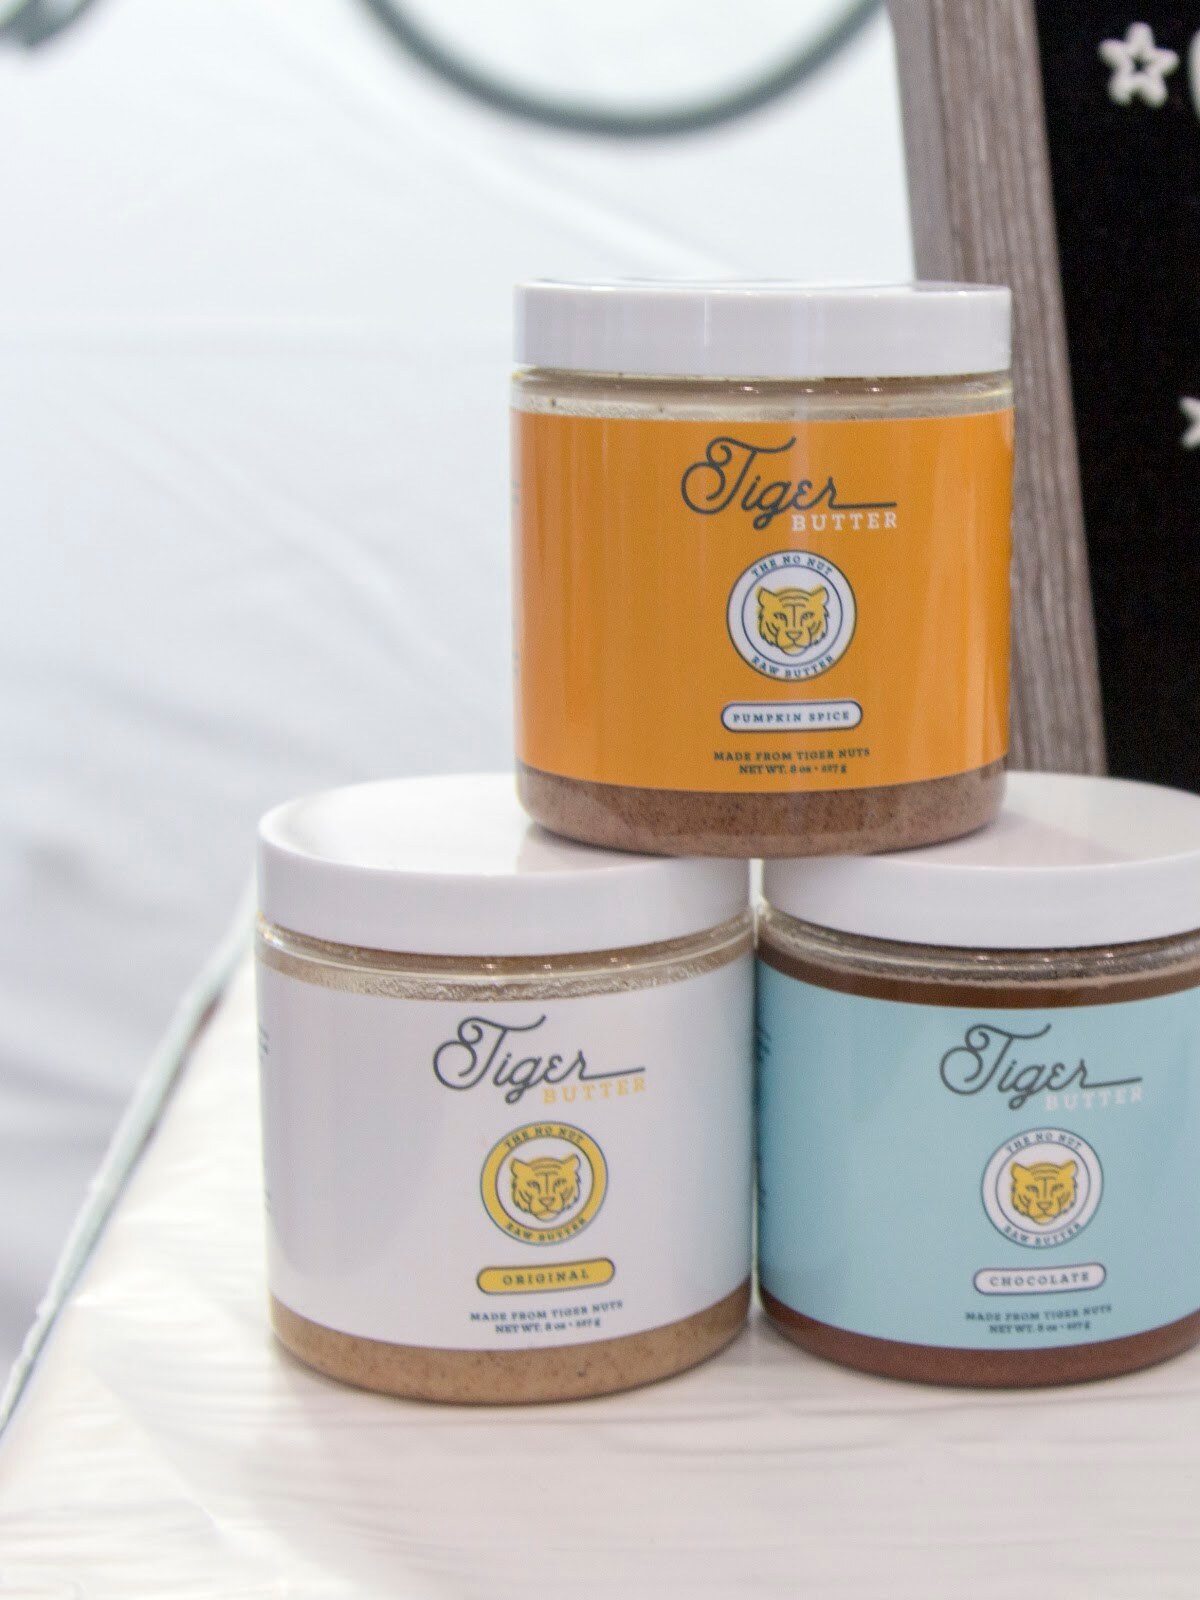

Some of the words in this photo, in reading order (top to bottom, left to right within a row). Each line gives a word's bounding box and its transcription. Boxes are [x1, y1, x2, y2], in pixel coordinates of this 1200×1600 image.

[681, 436, 898, 530] Tiger
[791, 512, 898, 532] BUTTER
[751, 559, 777, 577] THE
[782, 555, 801, 565] NO
[807, 558, 833, 575] NUT
[753, 656, 779, 674] RAW
[785, 655, 833, 678] BUTTER
[732, 713, 802, 723] PUMPKIN
[809, 711, 850, 721] SPICE
[714, 751, 750, 761] MADE
[756, 751, 792, 761] FROM
[797, 750, 834, 760] TIGER
[839, 748, 870, 758] NUTS
[433, 1014, 646, 1105] Tiger
[940, 1023, 1143, 1110] Tiger
[543, 1077, 646, 1105] BUTTER
[1045, 1087, 1144, 1112] BUTTER
[502, 1268, 590, 1286] ORIGINAL
[989, 1271, 1090, 1287] CHOCOLATE
